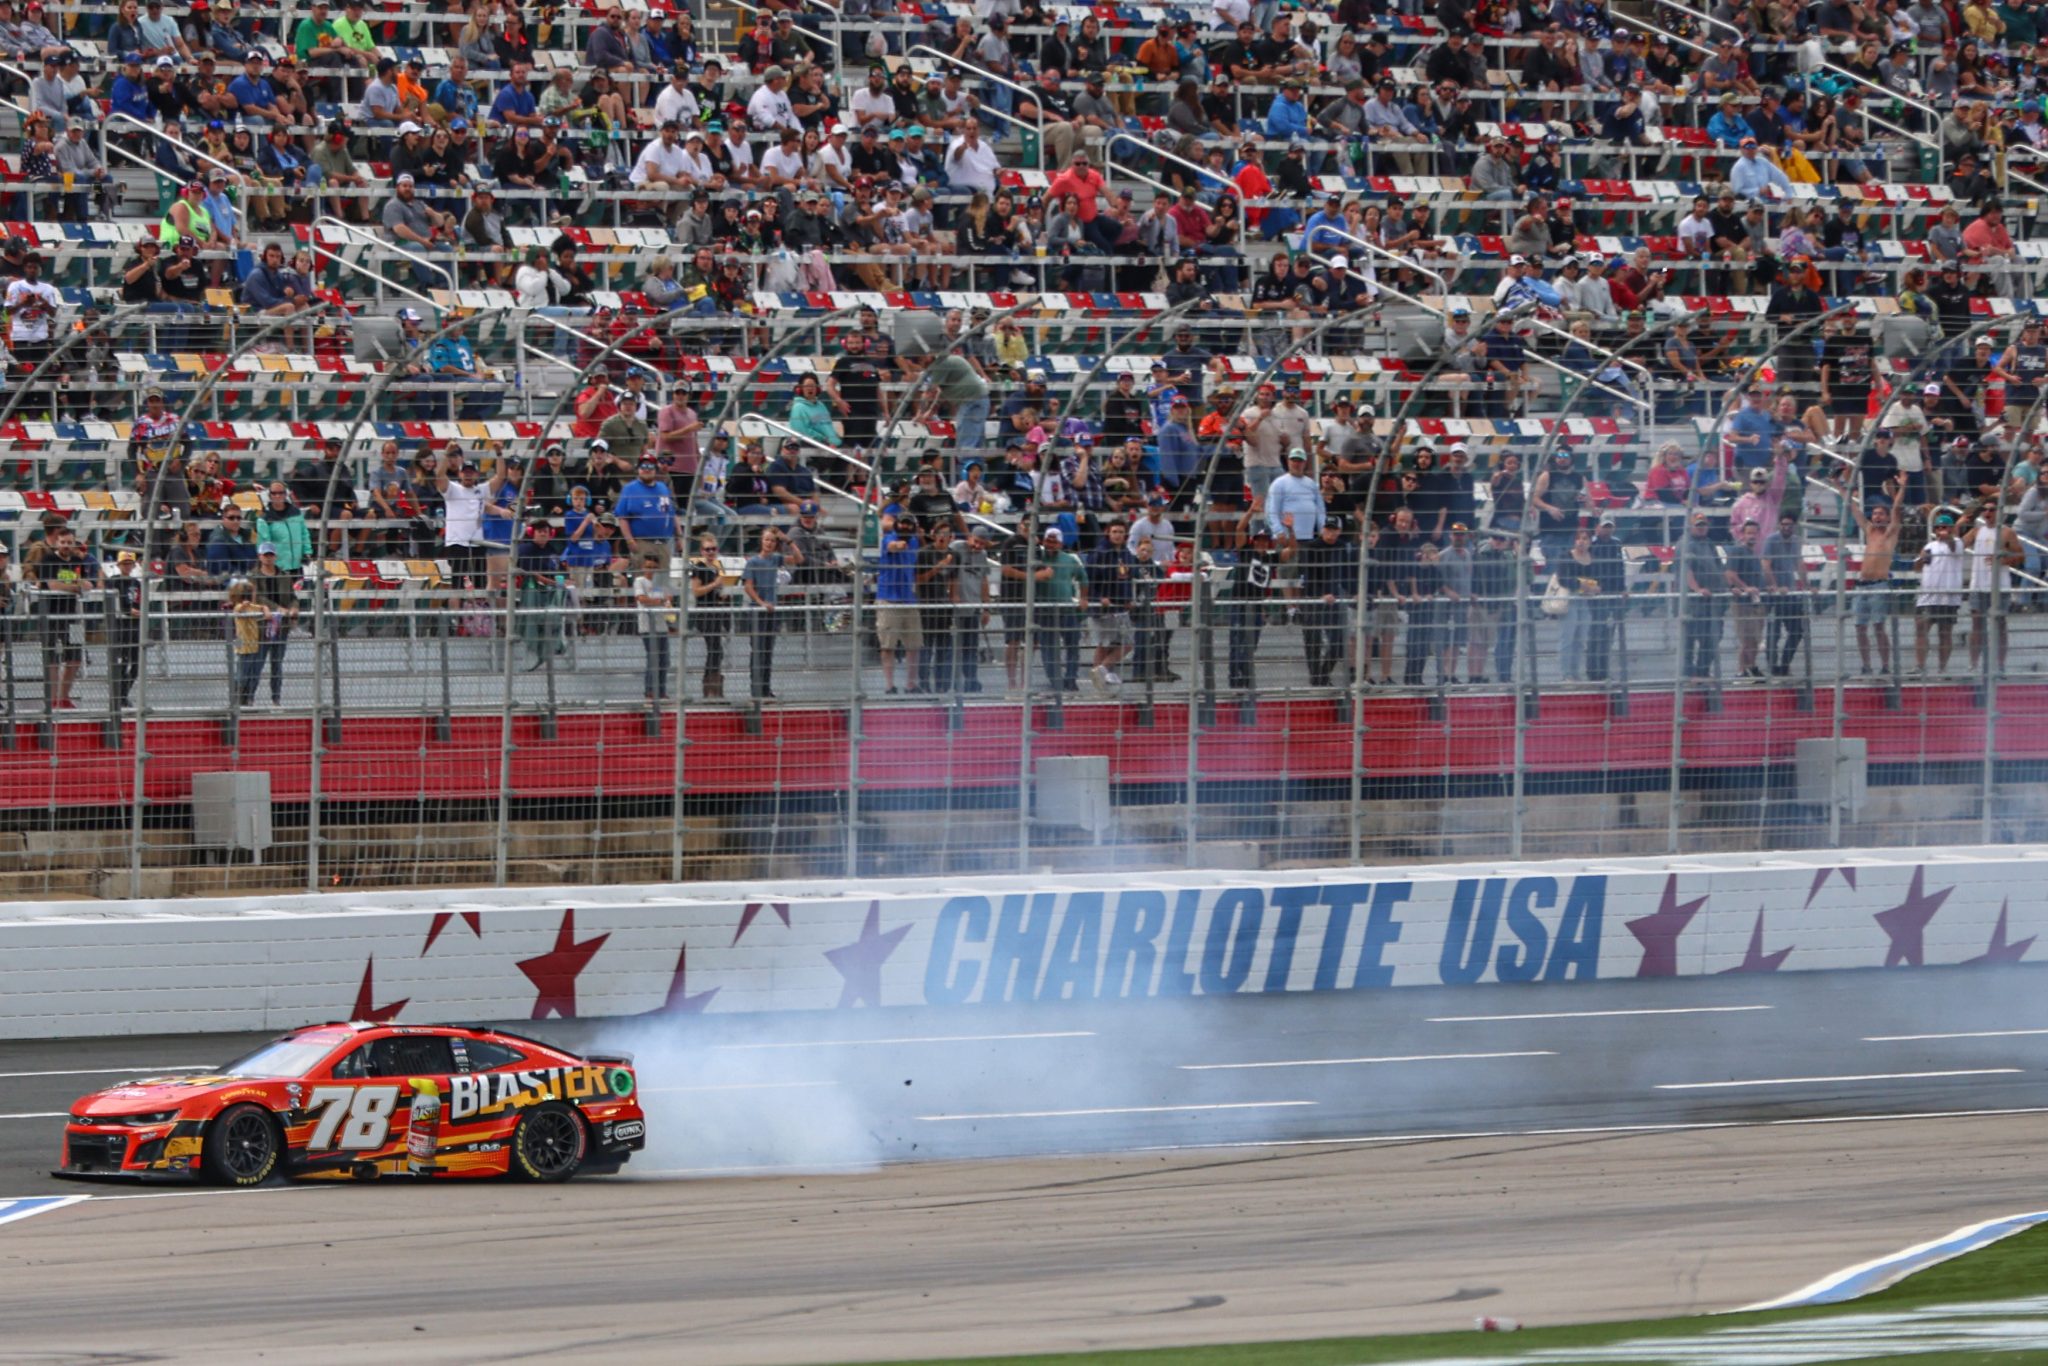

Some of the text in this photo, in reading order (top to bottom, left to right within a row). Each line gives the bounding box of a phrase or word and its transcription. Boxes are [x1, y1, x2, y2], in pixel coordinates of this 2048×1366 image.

[923, 875, 1608, 1004] CHARLOTTE USA
[305, 1085, 400, 1151] 78
